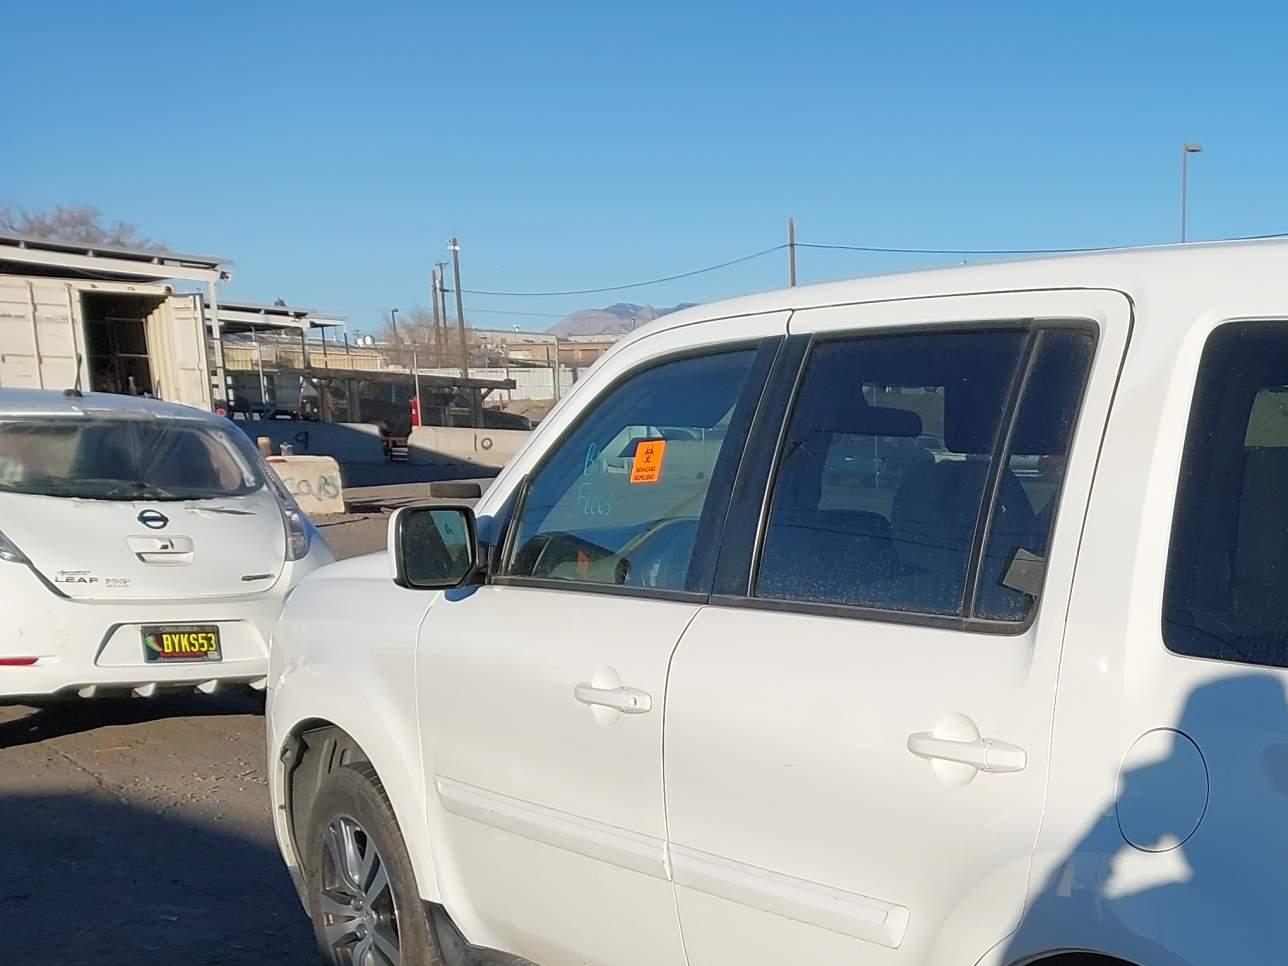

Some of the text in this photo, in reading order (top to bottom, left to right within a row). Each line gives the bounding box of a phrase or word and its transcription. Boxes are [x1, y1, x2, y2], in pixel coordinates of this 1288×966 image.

[474, 433, 493, 452] 10
[55, 576, 99, 584] LEAF
[161, 632, 217, 653] BYKS53
